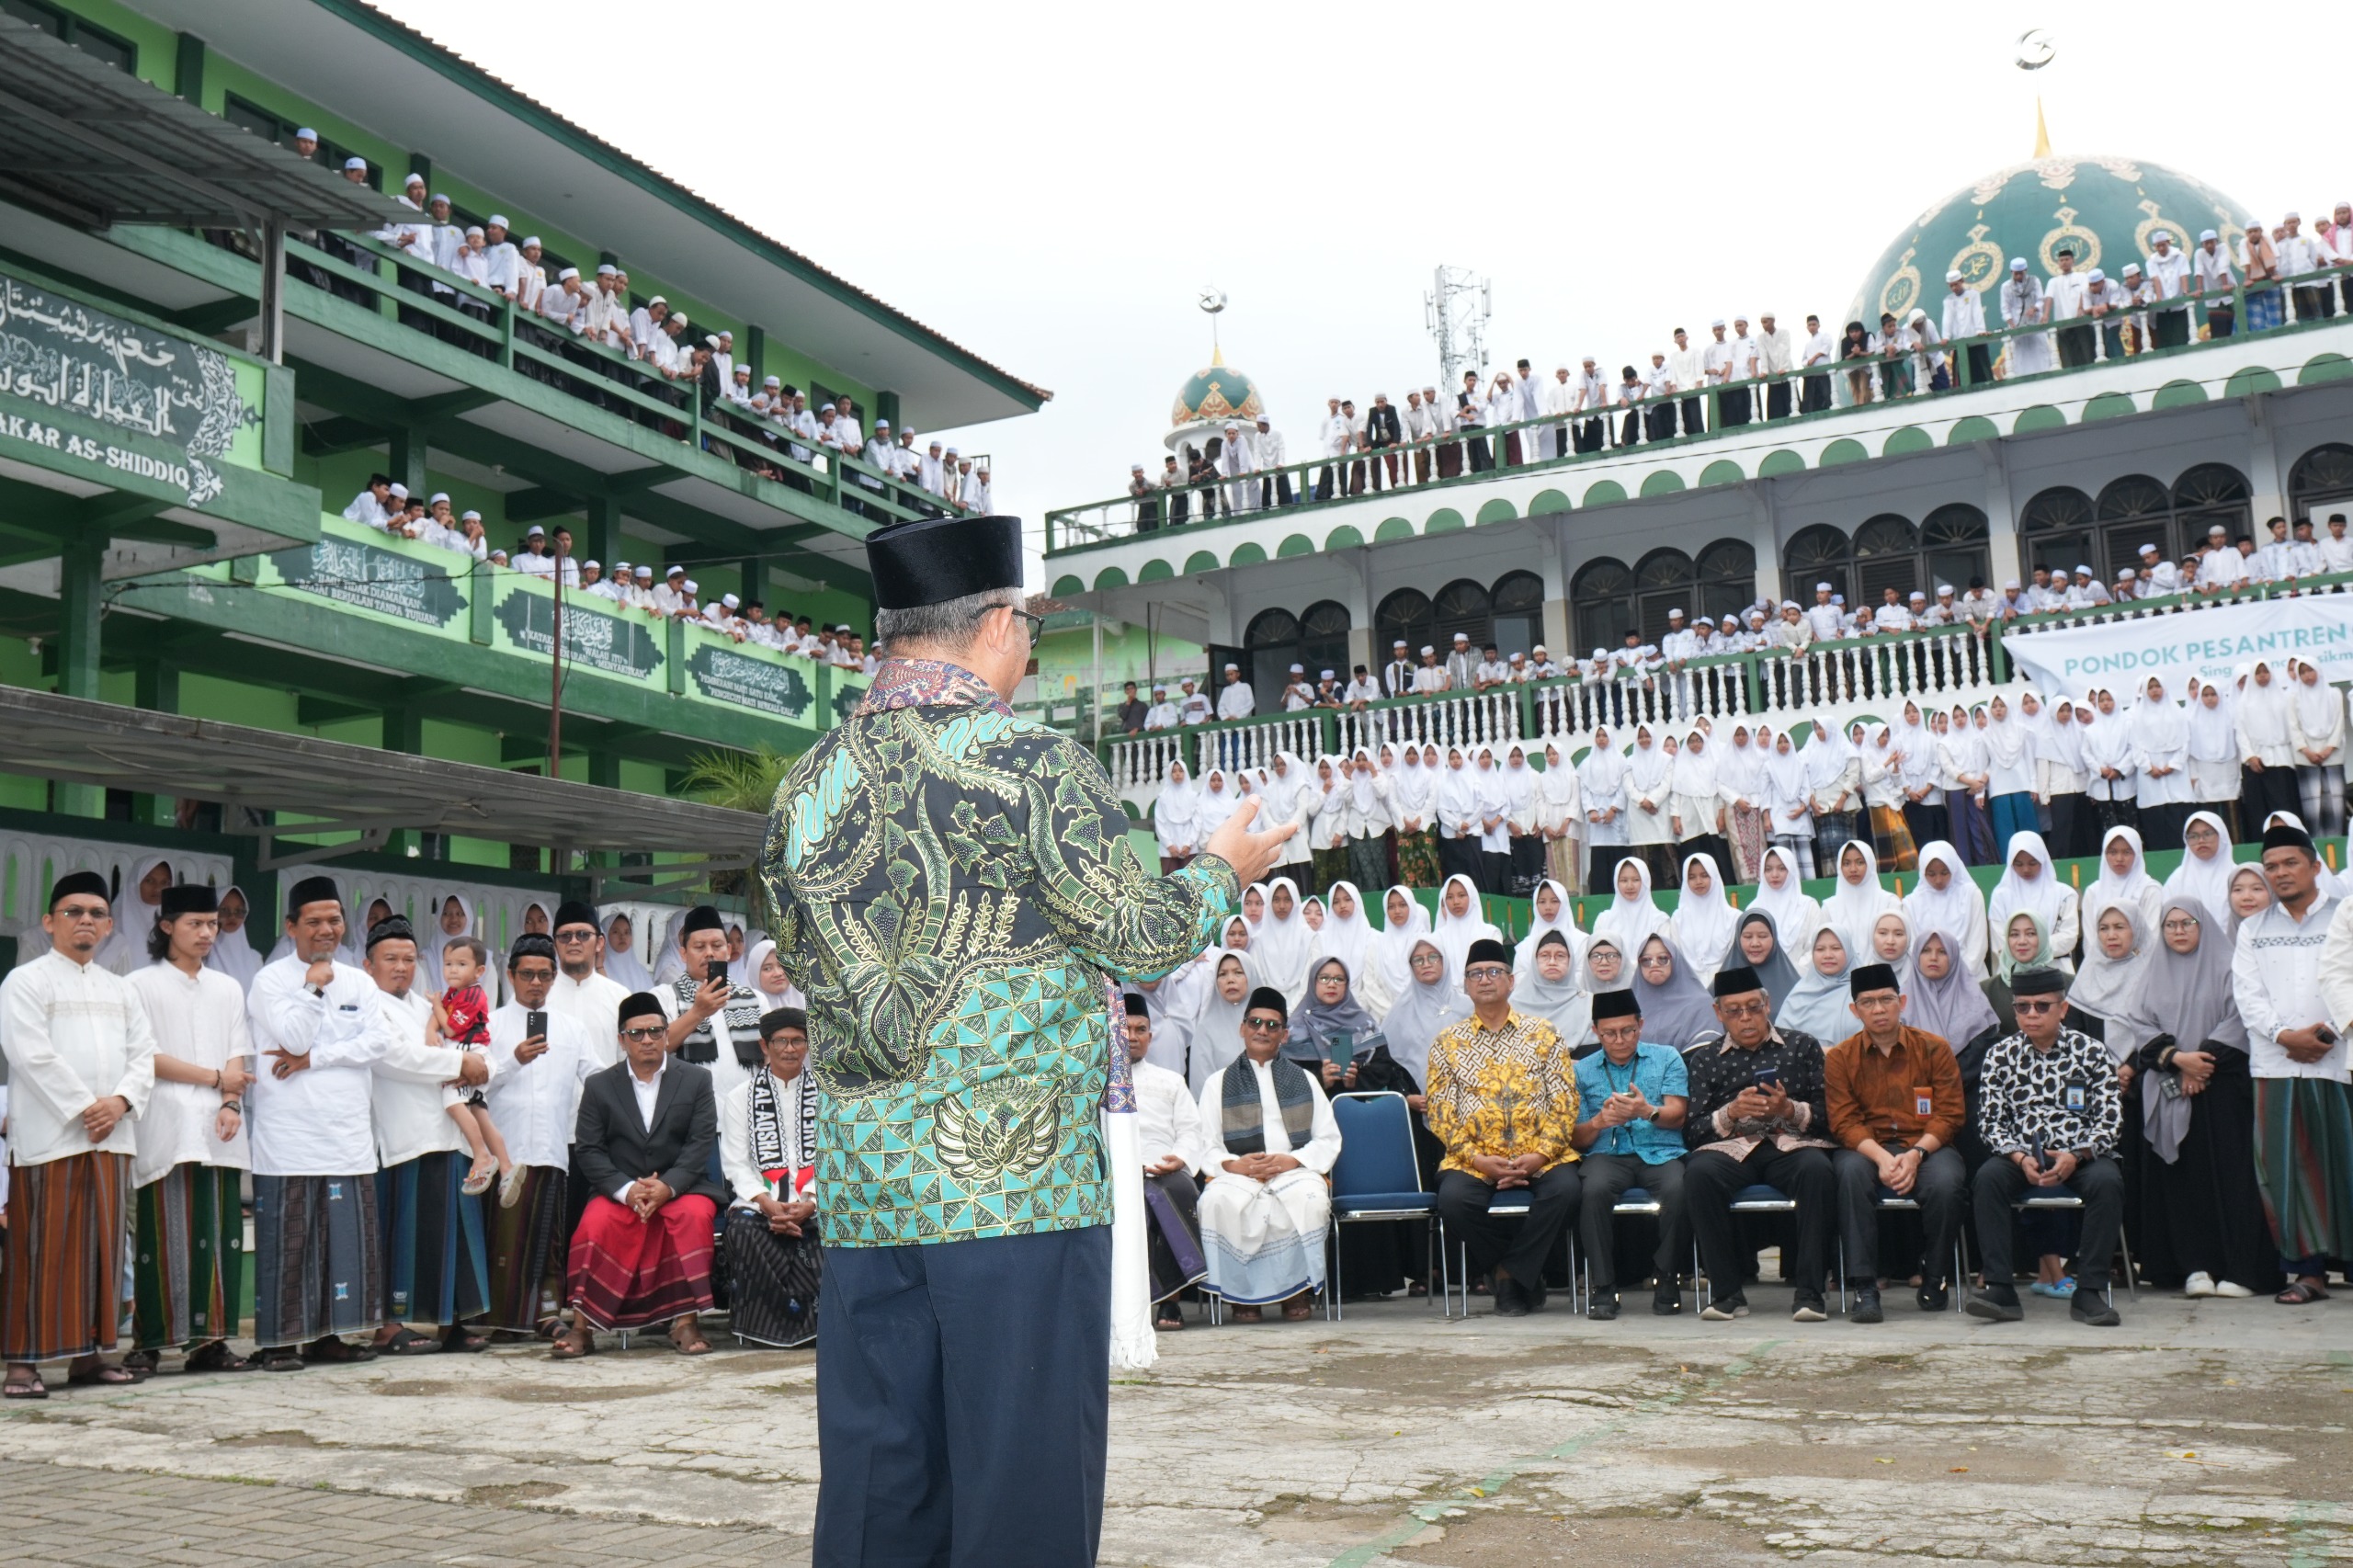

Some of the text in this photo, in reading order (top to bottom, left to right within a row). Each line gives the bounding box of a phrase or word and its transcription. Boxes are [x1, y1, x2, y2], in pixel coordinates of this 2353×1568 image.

[65, 434, 190, 492] AS-SHIDDIQ
[330, 588, 375, 608] BERJALAN
[374, 599, 404, 617] TANPA
[2064, 623, 2347, 676] PONDOK PESANTREN
[755, 1086, 780, 1163] AL-AQSHA
